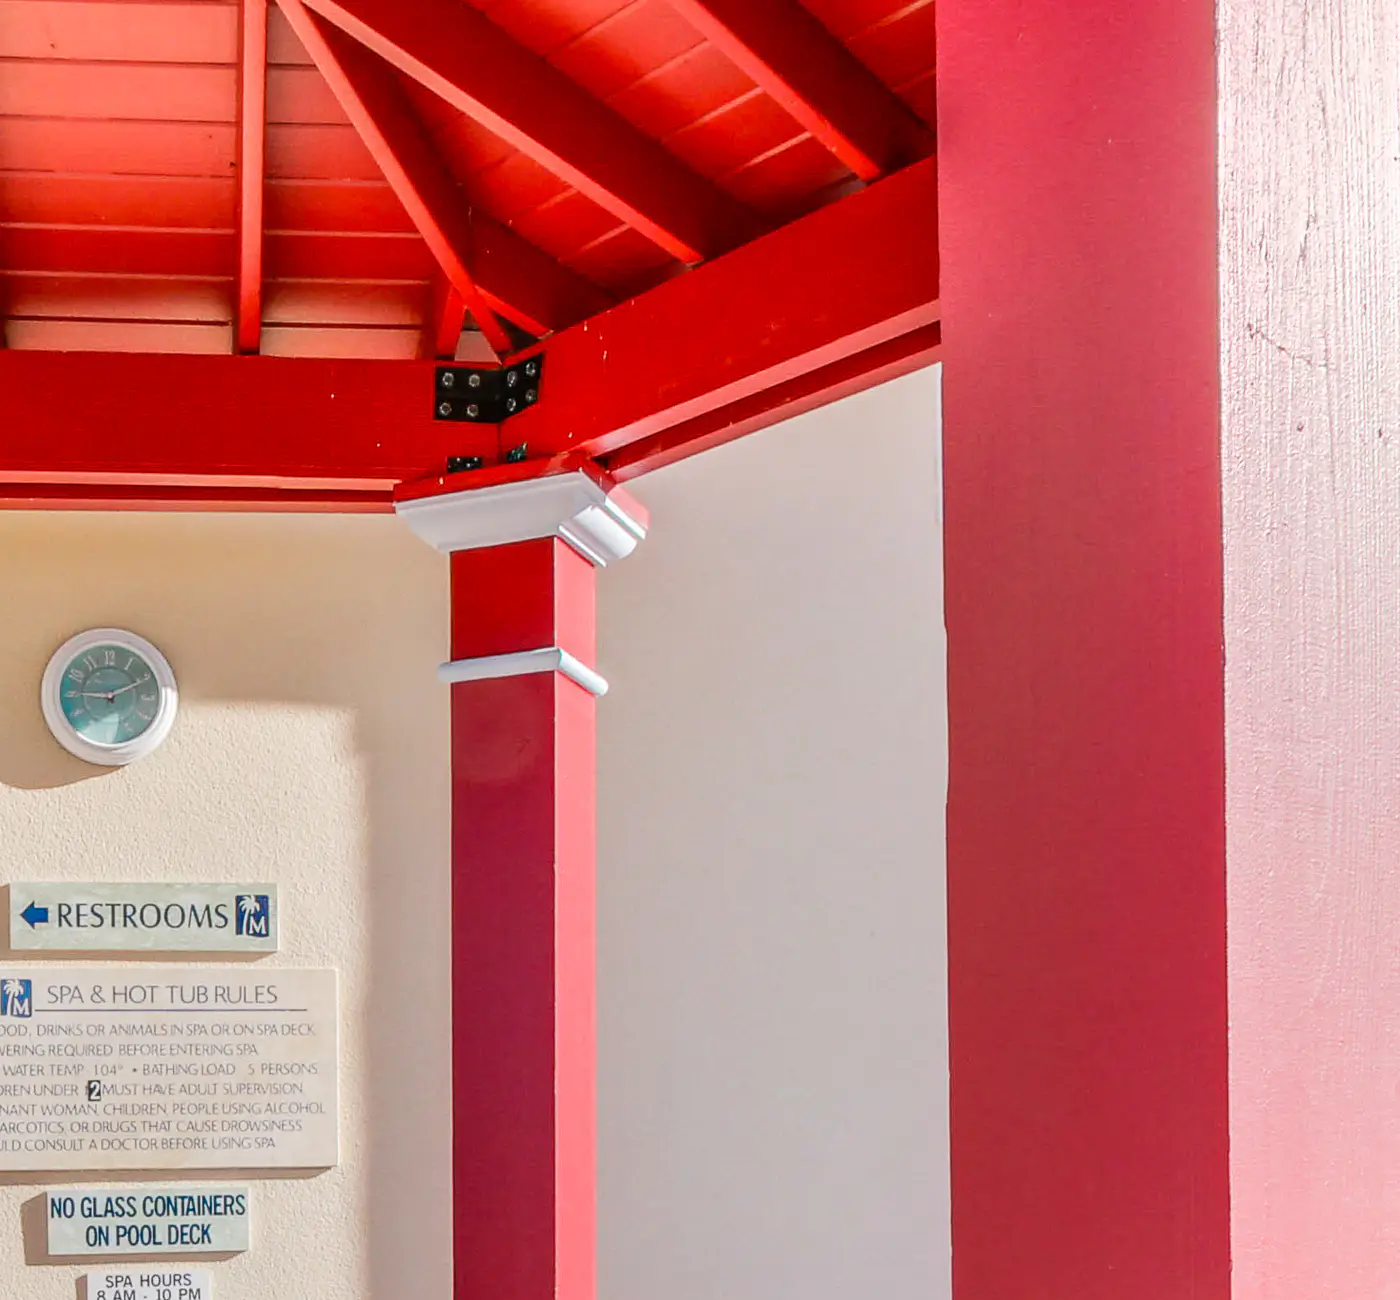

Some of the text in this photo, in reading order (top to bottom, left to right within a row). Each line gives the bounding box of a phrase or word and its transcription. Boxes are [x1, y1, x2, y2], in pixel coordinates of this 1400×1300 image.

[104, 650, 116, 666] 12
[57, 902, 229, 928] RESTROOMS
[249, 914, 267, 935] M
[47, 984, 278, 1004] SPA & HOT TUB RULES
[12, 997, 30, 1016] M
[36, 1023, 84, 1037] DRINKS
[86, 1023, 105, 1037] OR
[109, 1023, 168, 1036] ANIMALS
[170, 1023, 184, 1036] IN
[186, 1023, 209, 1036] SPA
[211, 1023, 231, 1036] OR
[233, 1023, 255, 1036] ON
[257, 1023, 279, 1036] SPA
[281, 1023, 317, 1037] DECK
[48, 1043, 114, 1057] REQUIRED
[119, 1043, 167, 1056] BEFORE
[169, 1043, 234, 1056] ENTERING
[236, 1043, 260, 1056] SPA
[2, 1064, 45, 1077] WATER
[48, 1063, 85, 1076] TEMP
[142, 1063, 199, 1076] BATHING
[201, 1063, 236, 1076] LOAD
[261, 1062, 318, 1075] PERSONS
[33, 1083, 79, 1097] UNDER
[102, 1083, 139, 1096] MUST
[143, 1083, 176, 1096] HAVE
[179, 1083, 218, 1096] ADULT
[222, 1082, 304, 1096] SUPERVISION
[172, 1102, 219, 1115] PEOPLE
[221, 1102, 265, 1115] USING
[265, 1101, 326, 1115] ALCOHOL
[70, 1121, 89, 1133] OR
[92, 1120, 137, 1133] DRUGS
[140, 1120, 173, 1133] THAT
[176, 1120, 221, 1133] CAUSE
[221, 1119, 303, 1133] DROWSINESS
[24, 1138, 86, 1152] CONSULT
[88, 1138, 98, 1150] A
[100, 1138, 158, 1151] DOCTOR
[161, 1137, 208, 1150] BEFORE
[211, 1137, 251, 1150] USING
[254, 1137, 276, 1149] SPA
[51, 1194, 246, 1218] NO GLASS CONTAINERS
[85, 1223, 212, 1247] ON POOL DECK
[105, 1273, 192, 1288] SPA HOURS
[178, 1288, 201, 1300] PM
